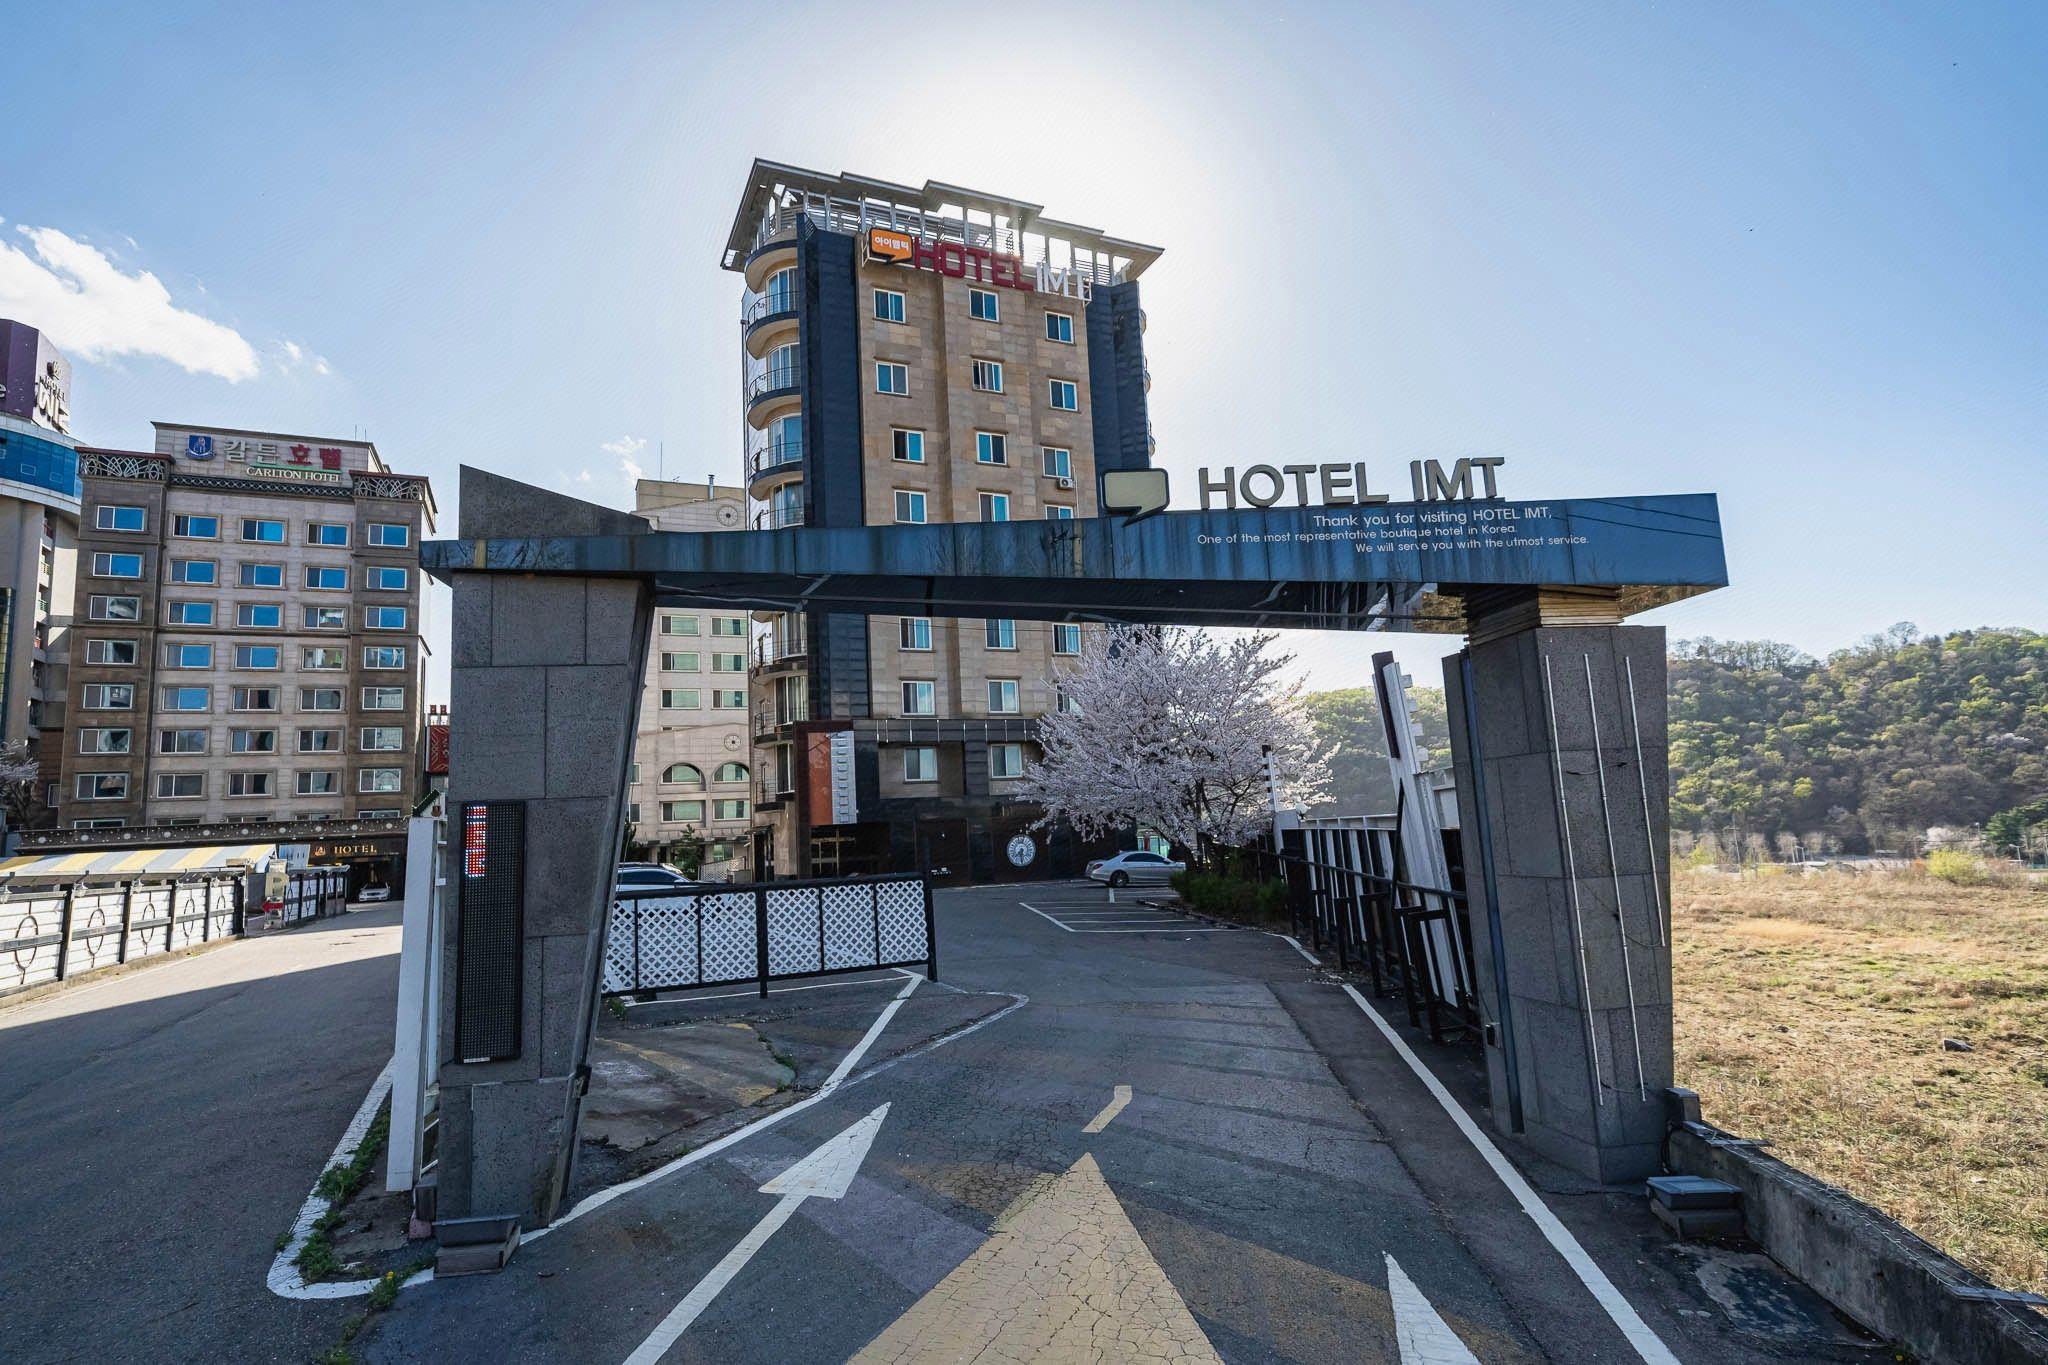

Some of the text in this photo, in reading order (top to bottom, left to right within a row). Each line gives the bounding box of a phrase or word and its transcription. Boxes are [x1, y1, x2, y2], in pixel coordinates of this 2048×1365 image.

[914, 236, 1092, 300] HOTEL IMT
[224, 439, 342, 470] 칼튼 호텔
[246, 466, 341, 482] CARLTON HOTEL
[1199, 456, 1506, 510] HOTEL IMT
[1313, 515, 1358, 527] Thank
[1363, 517, 1390, 528] you
[1395, 512, 1415, 523] for
[1420, 511, 1467, 524] visiting
[1473, 509, 1521, 521] HOTEL
[1197, 534, 1222, 544] One
[1225, 533, 1238, 543] of
[1241, 531, 1261, 542] the
[1264, 532, 1290, 542] most
[1295, 530, 1376, 542] representative
[1380, 527, 1432, 540] boutique
[1434, 526, 1464, 536] hotel
[1467, 526, 1478, 535] in
[1355, 534, 1590, 553] We will serve you with the utmost service.
[334, 844, 377, 854] HOTEL
